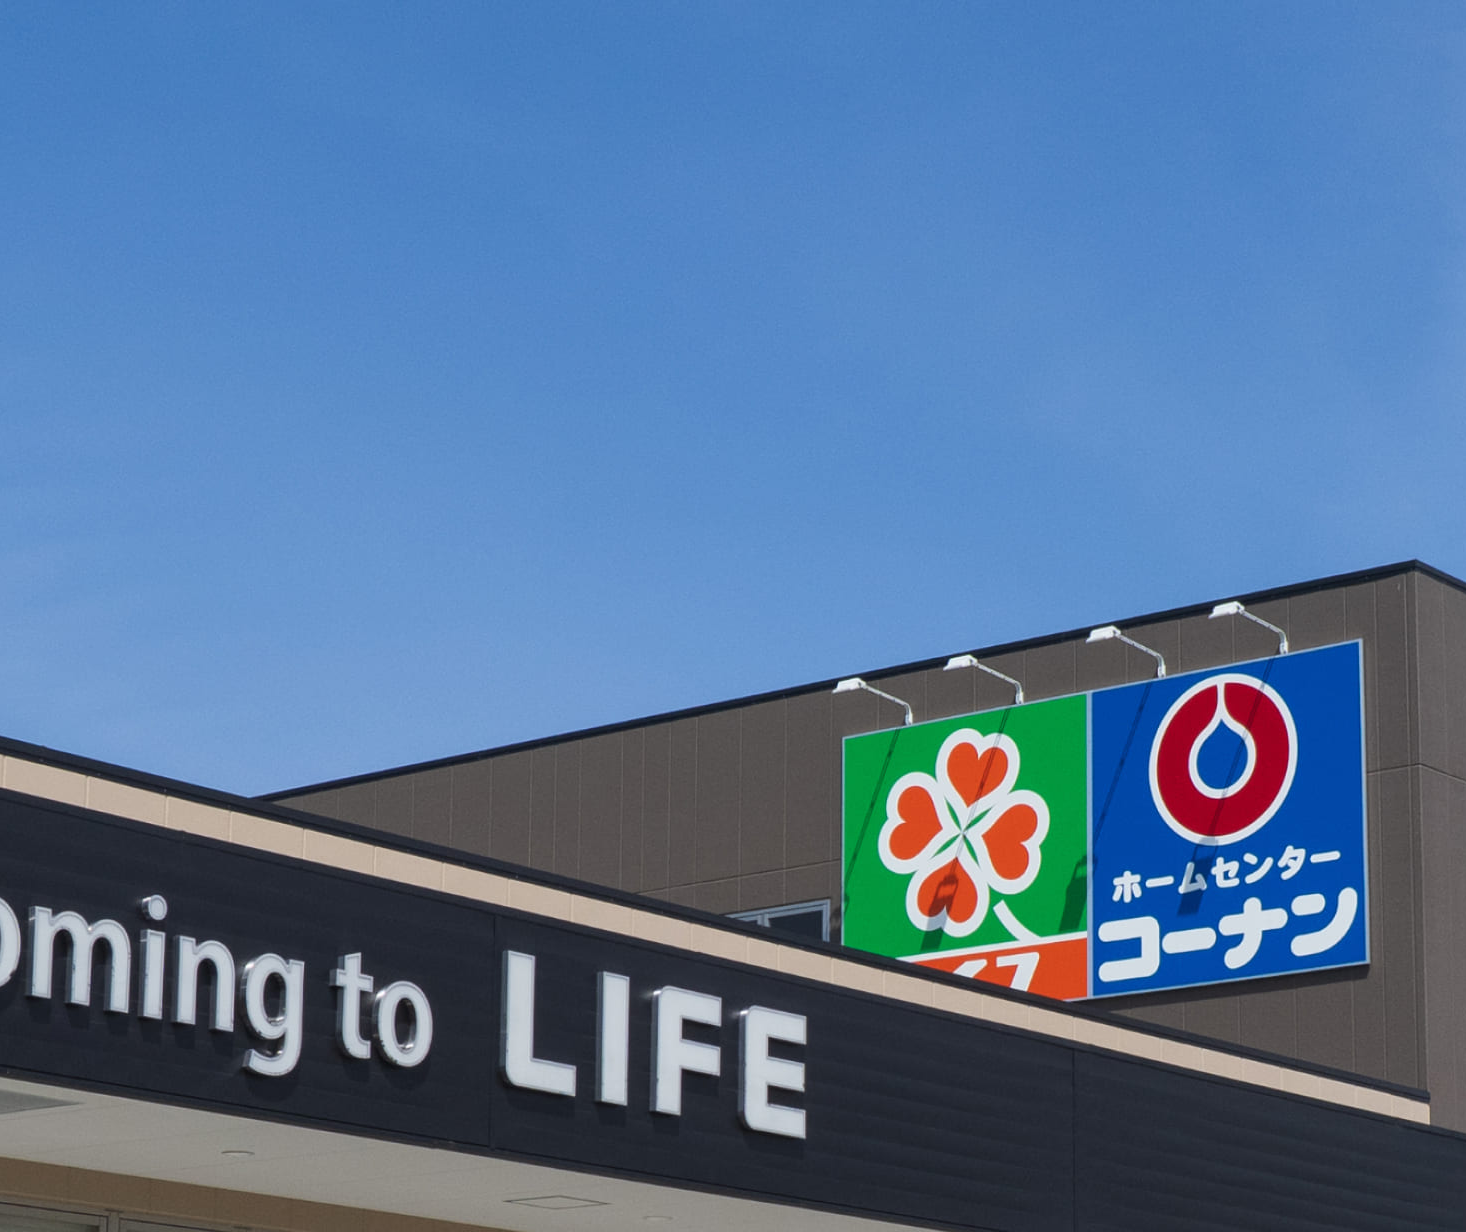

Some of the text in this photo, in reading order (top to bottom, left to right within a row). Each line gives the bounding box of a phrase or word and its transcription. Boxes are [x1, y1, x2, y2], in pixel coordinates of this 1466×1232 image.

[1112, 845, 1341, 903] ホームセンター
[1098, 887, 1359, 983] コーナン
[330, 951, 433, 1068] to
[502, 949, 808, 1140] LIFE
